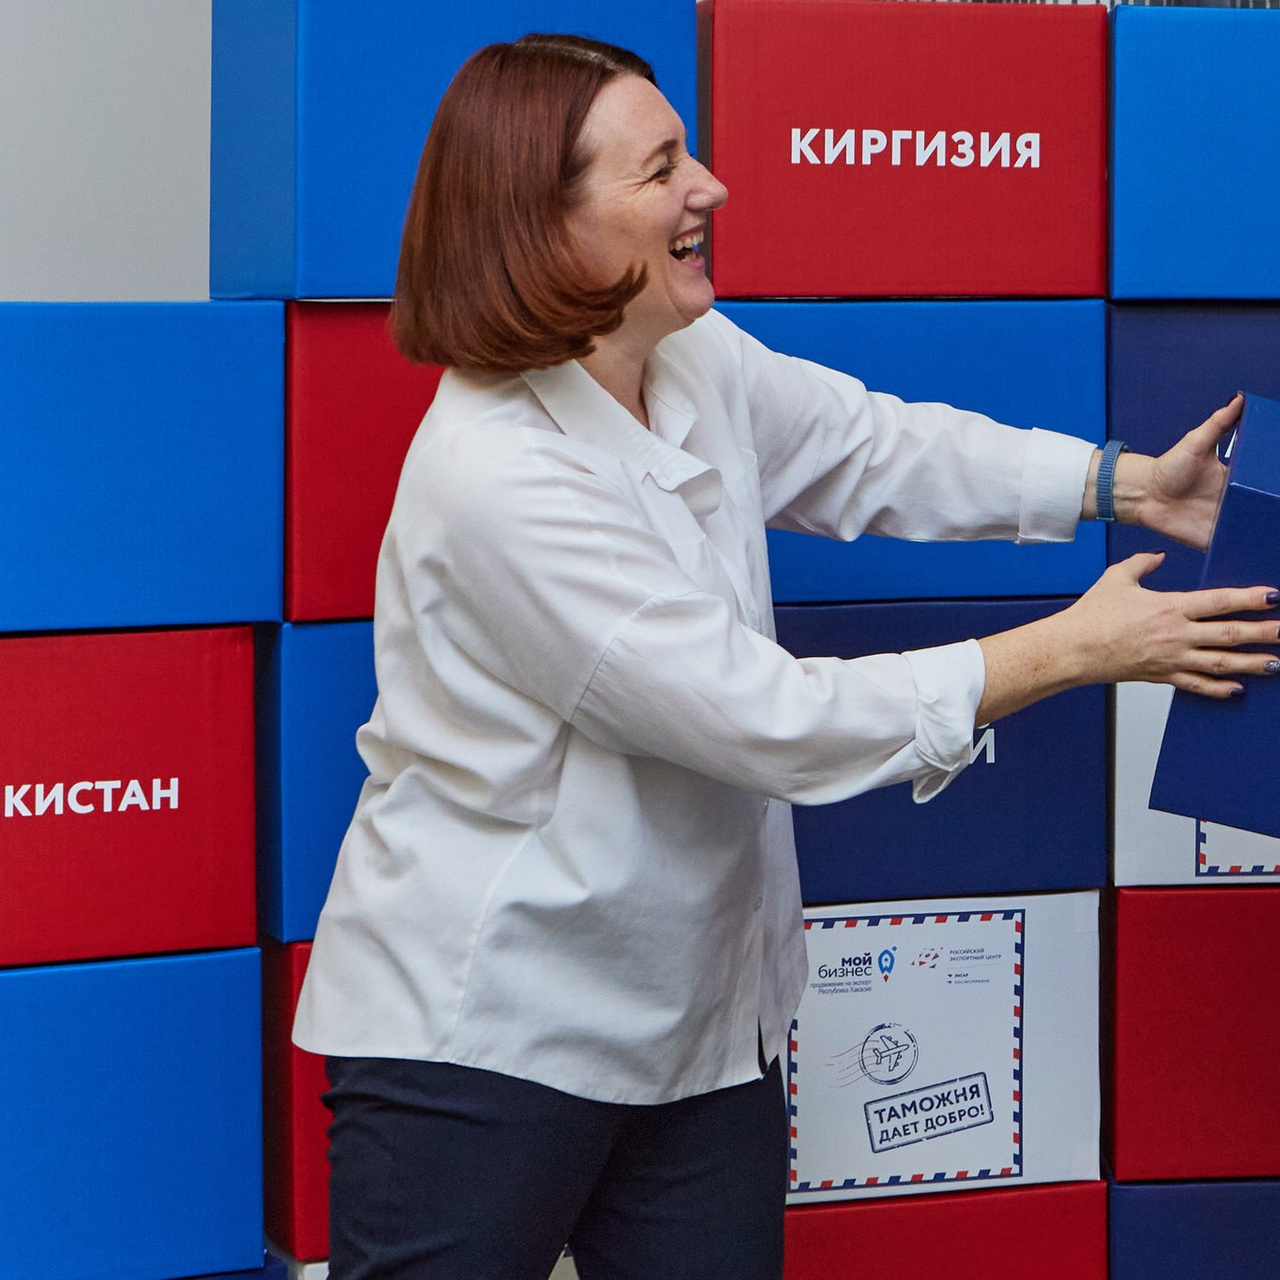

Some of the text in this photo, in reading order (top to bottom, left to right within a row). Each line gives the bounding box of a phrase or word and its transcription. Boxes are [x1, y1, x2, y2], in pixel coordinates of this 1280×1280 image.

[791, 128, 1040, 168] КИРГИЗИЯ
[4, 777, 179, 817] КИСТАН
[818, 964, 872, 978] бизнес
[841, 952, 872, 966] мой
[874, 1083, 981, 1124] ТАМОЖНЯ
[879, 1104, 985, 1144] ДАЕТ ДОБРО!
